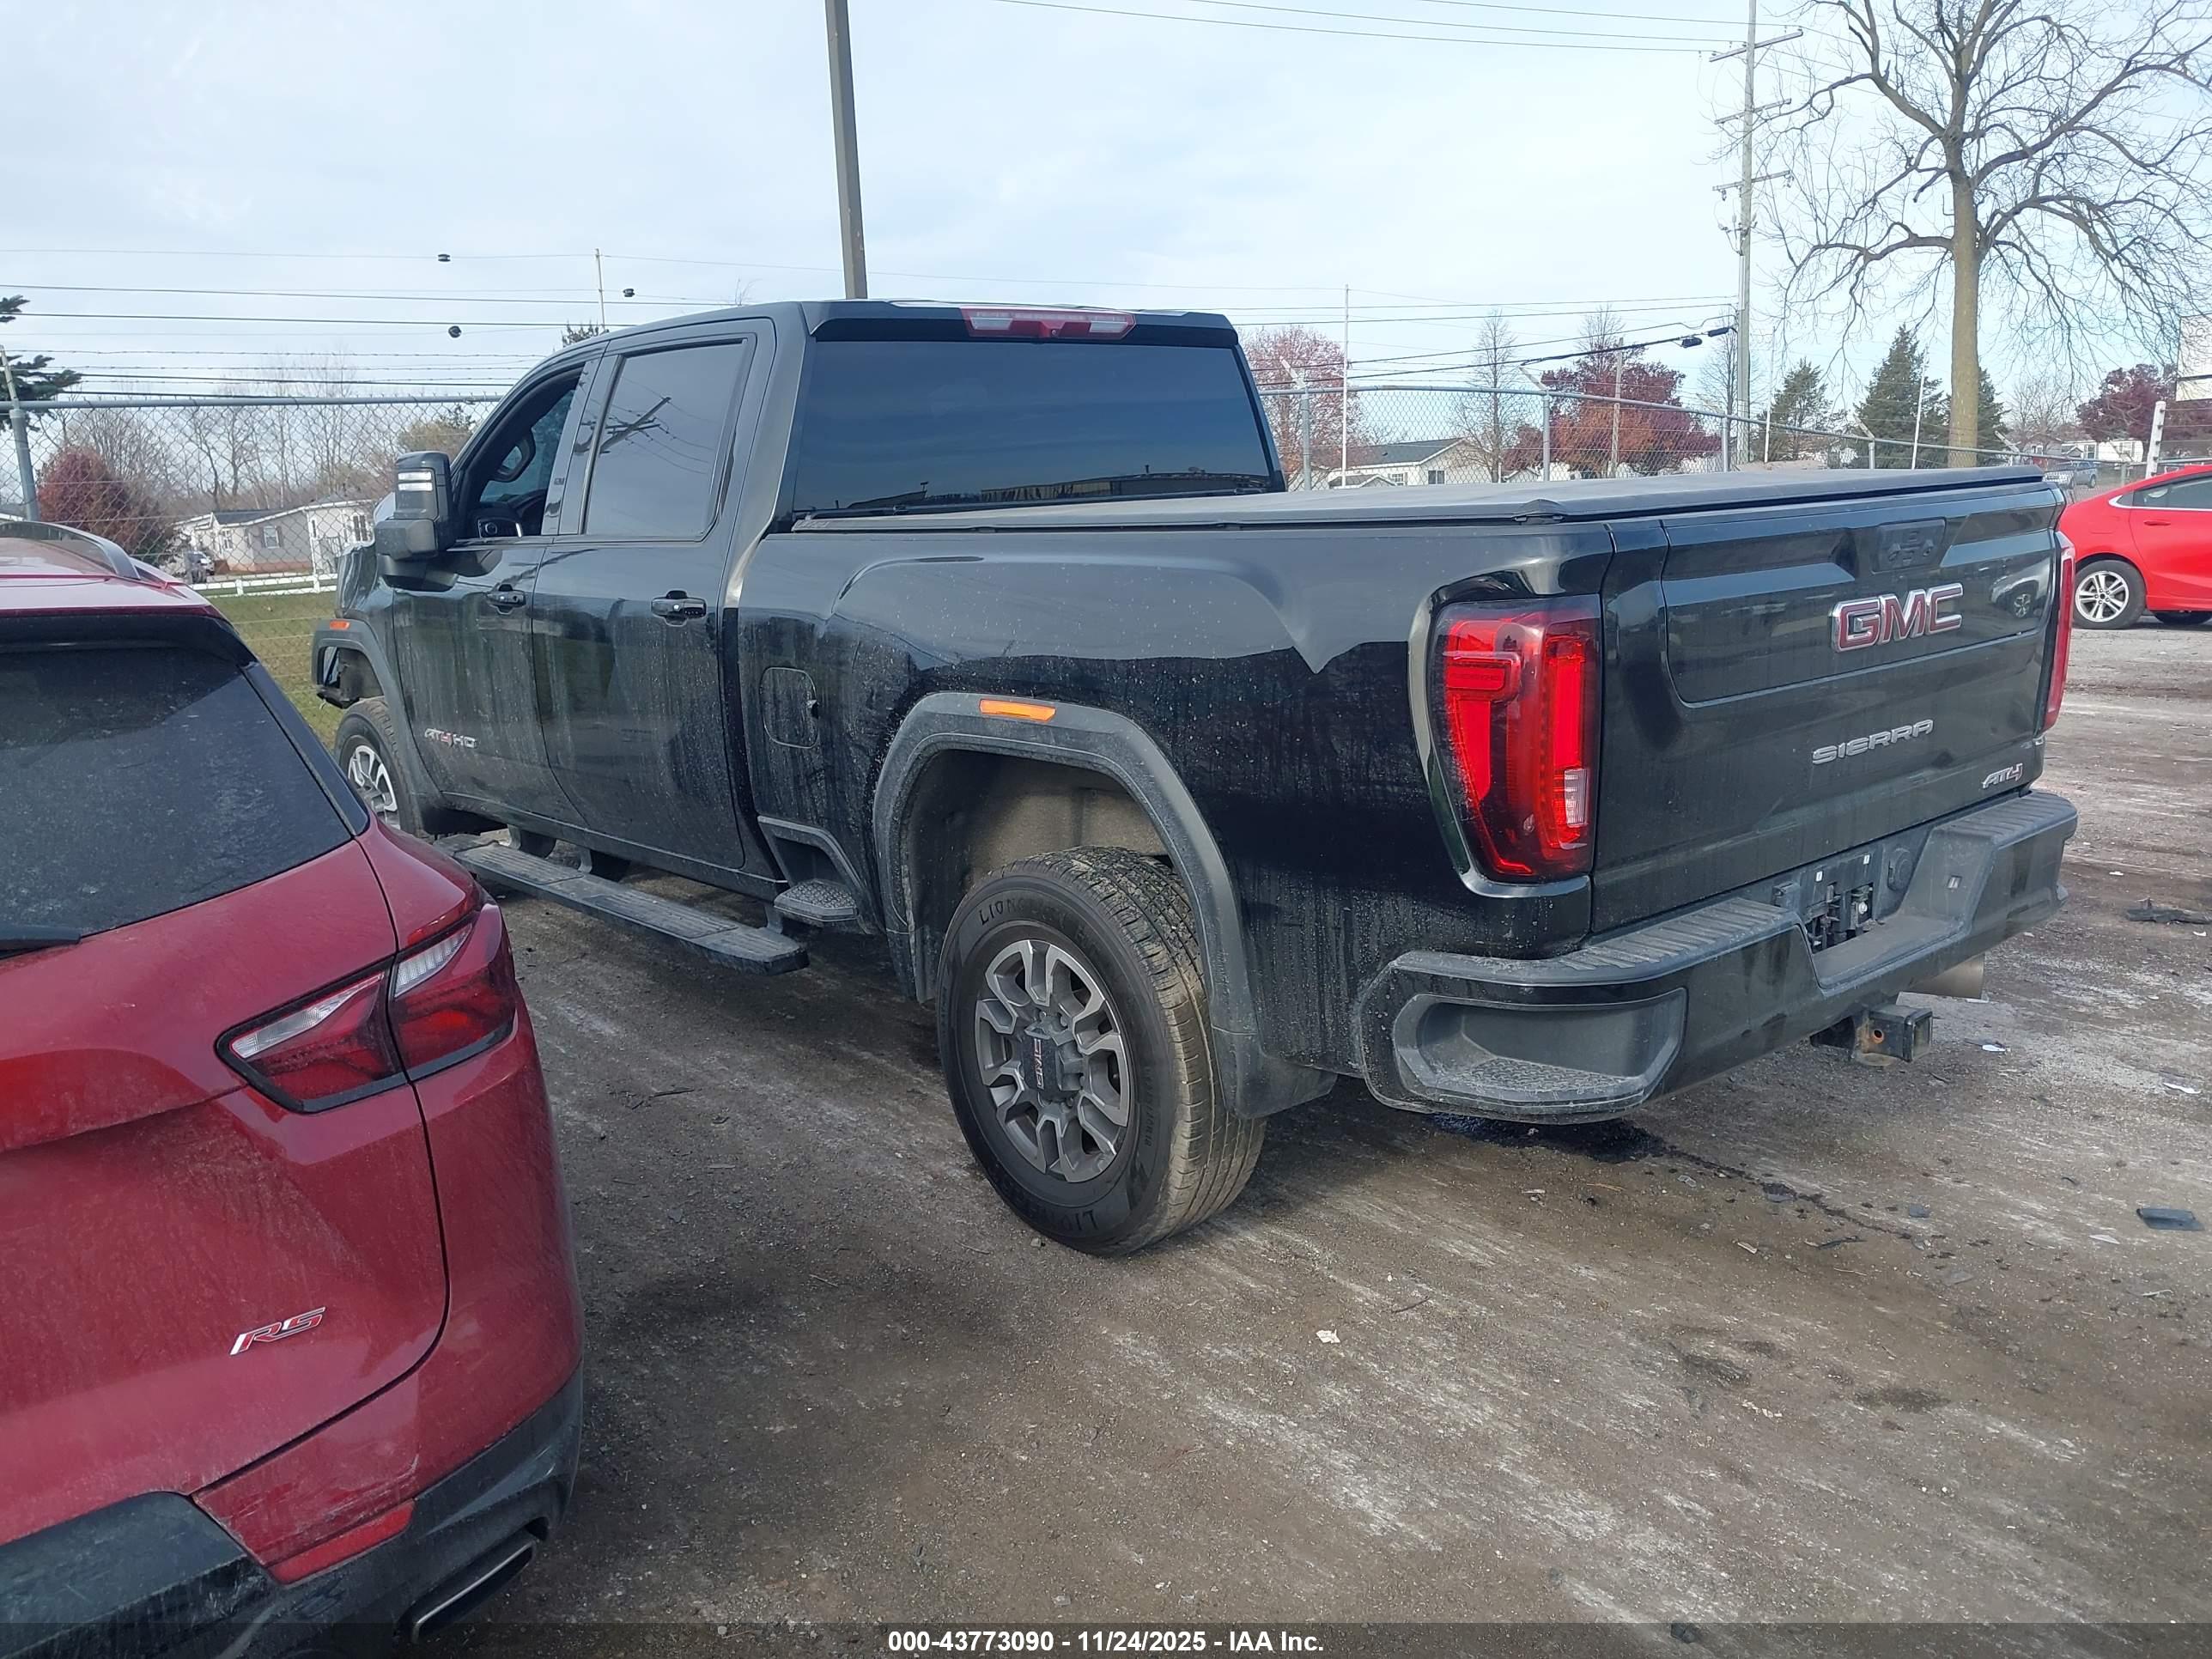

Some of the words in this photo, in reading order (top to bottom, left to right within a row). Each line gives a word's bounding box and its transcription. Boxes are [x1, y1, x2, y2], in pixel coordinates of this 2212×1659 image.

[1832, 583, 1964, 653] GMC
[1813, 719, 1934, 764] SIERRA
[1982, 763, 2023, 789] AT4
[1033, 1037, 1045, 1090] GMC
[229, 1306, 326, 1356] RS
